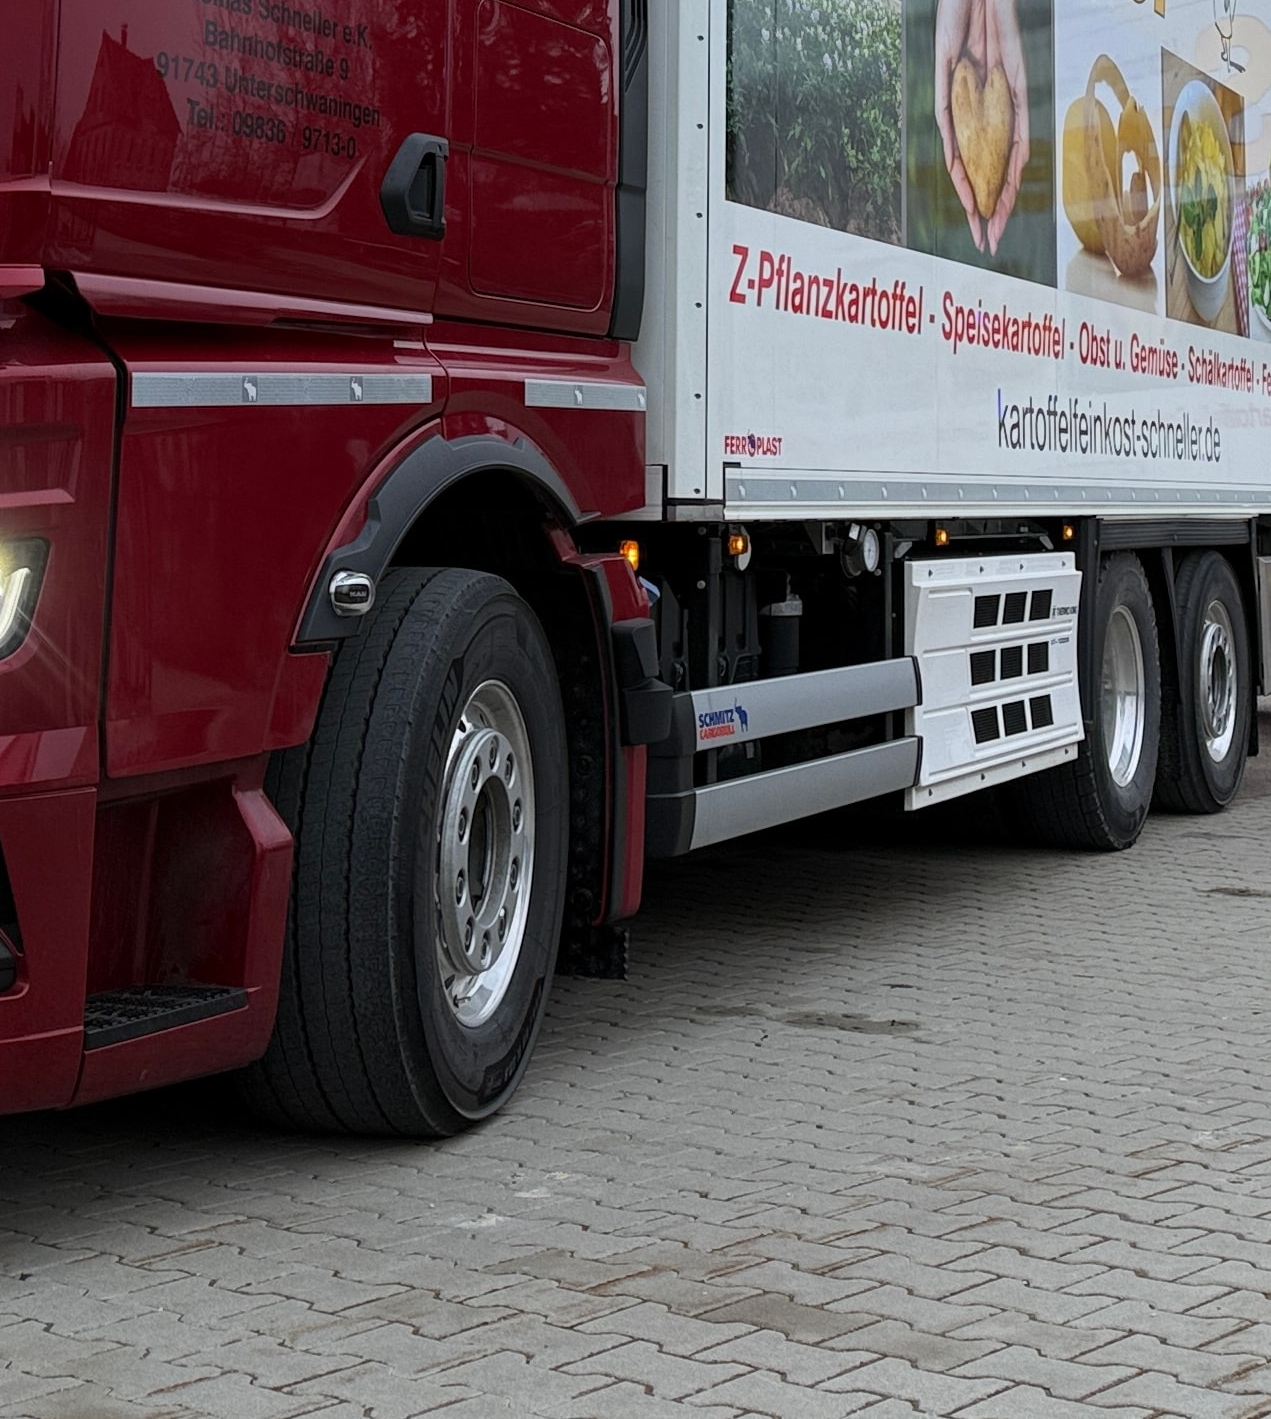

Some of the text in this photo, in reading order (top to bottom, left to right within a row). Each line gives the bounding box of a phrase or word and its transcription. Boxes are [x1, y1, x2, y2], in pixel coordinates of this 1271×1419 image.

[204, 19, 350, 81] Bahnhofstraße 9
[343, 22, 373, 50] e.K.
[156, 51, 381, 128] 91743 Unterschwaningen
[303, 125, 357, 160] 9713-0
[729, 244, 924, 335] Z-Pflanzkartoffel
[941, 291, 1066, 360] Speisekartoffel
[1079, 322, 1111, 369] Obst
[1114, 339, 1126, 371] u.
[1130, 333, 1179, 379] Gemüse
[1187, 345, 1255, 394] Schälkartoffel
[997, 388, 1222, 464] kartoffelfeinkost-schneller.de
[698, 708, 735, 729] SCHMITZ
